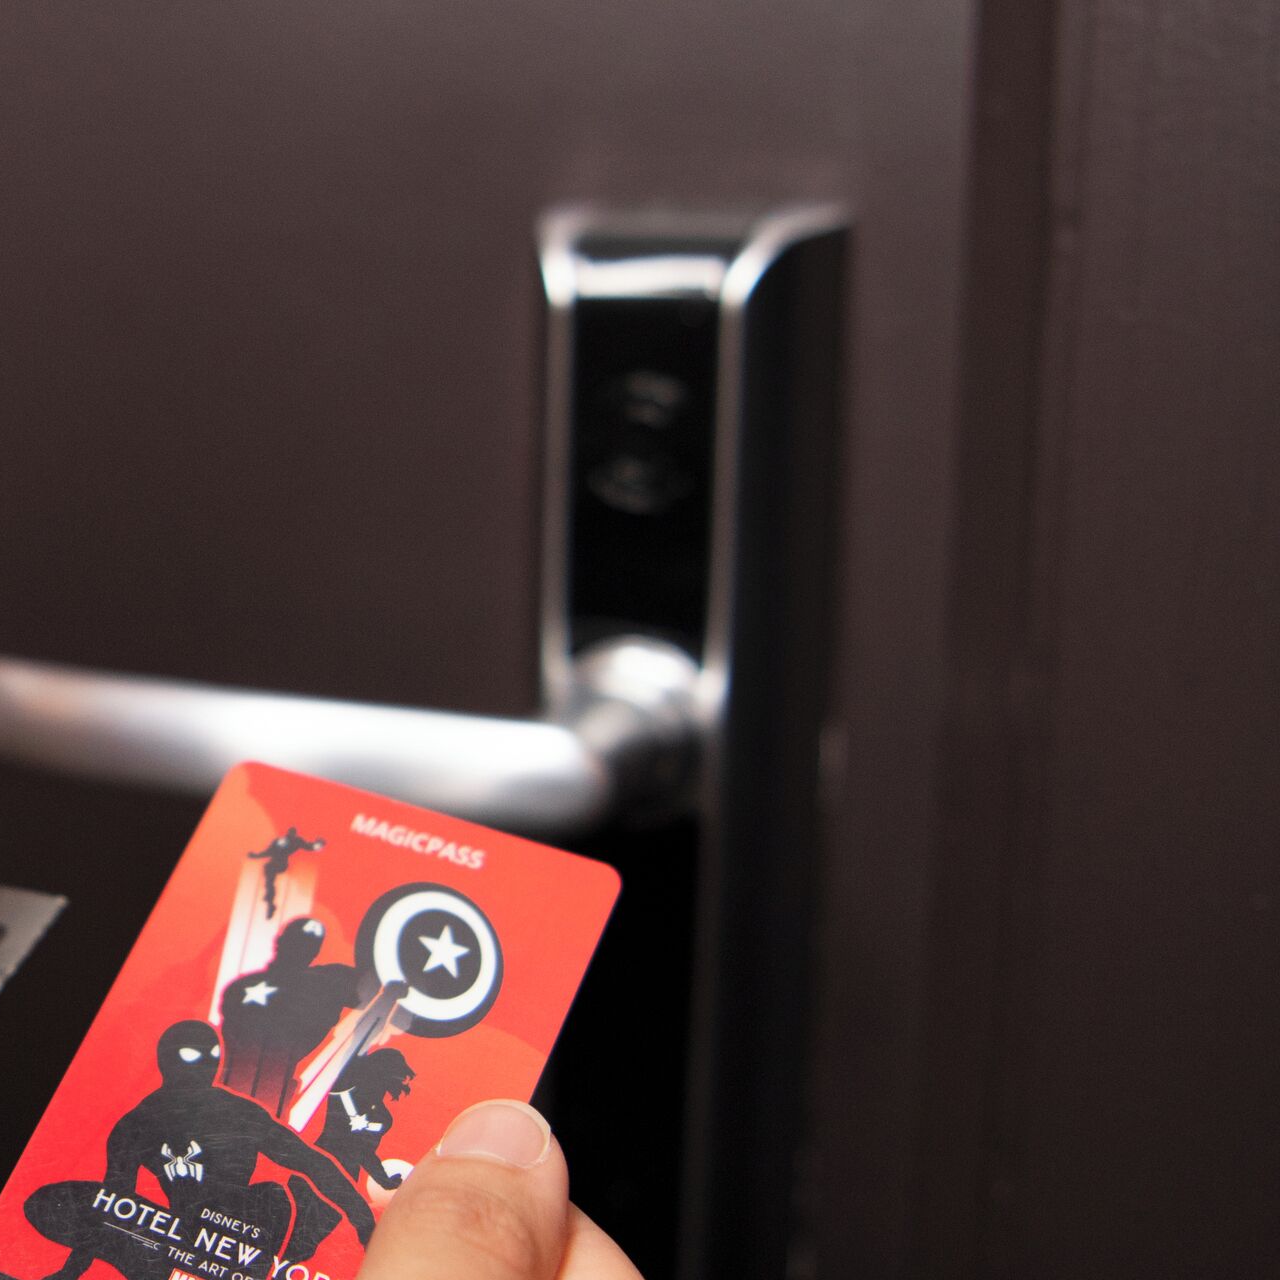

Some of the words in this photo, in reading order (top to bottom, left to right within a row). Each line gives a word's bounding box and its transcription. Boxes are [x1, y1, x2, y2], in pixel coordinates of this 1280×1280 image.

[350, 813, 486, 869] MAGICPASS
[92, 1189, 182, 1242] HOTEL
[194, 1228, 262, 1267] NEW
[200, 1208, 261, 1239] DISNEY'S
[168, 1245, 196, 1266] THE
[198, 1260, 228, 1279] ART
